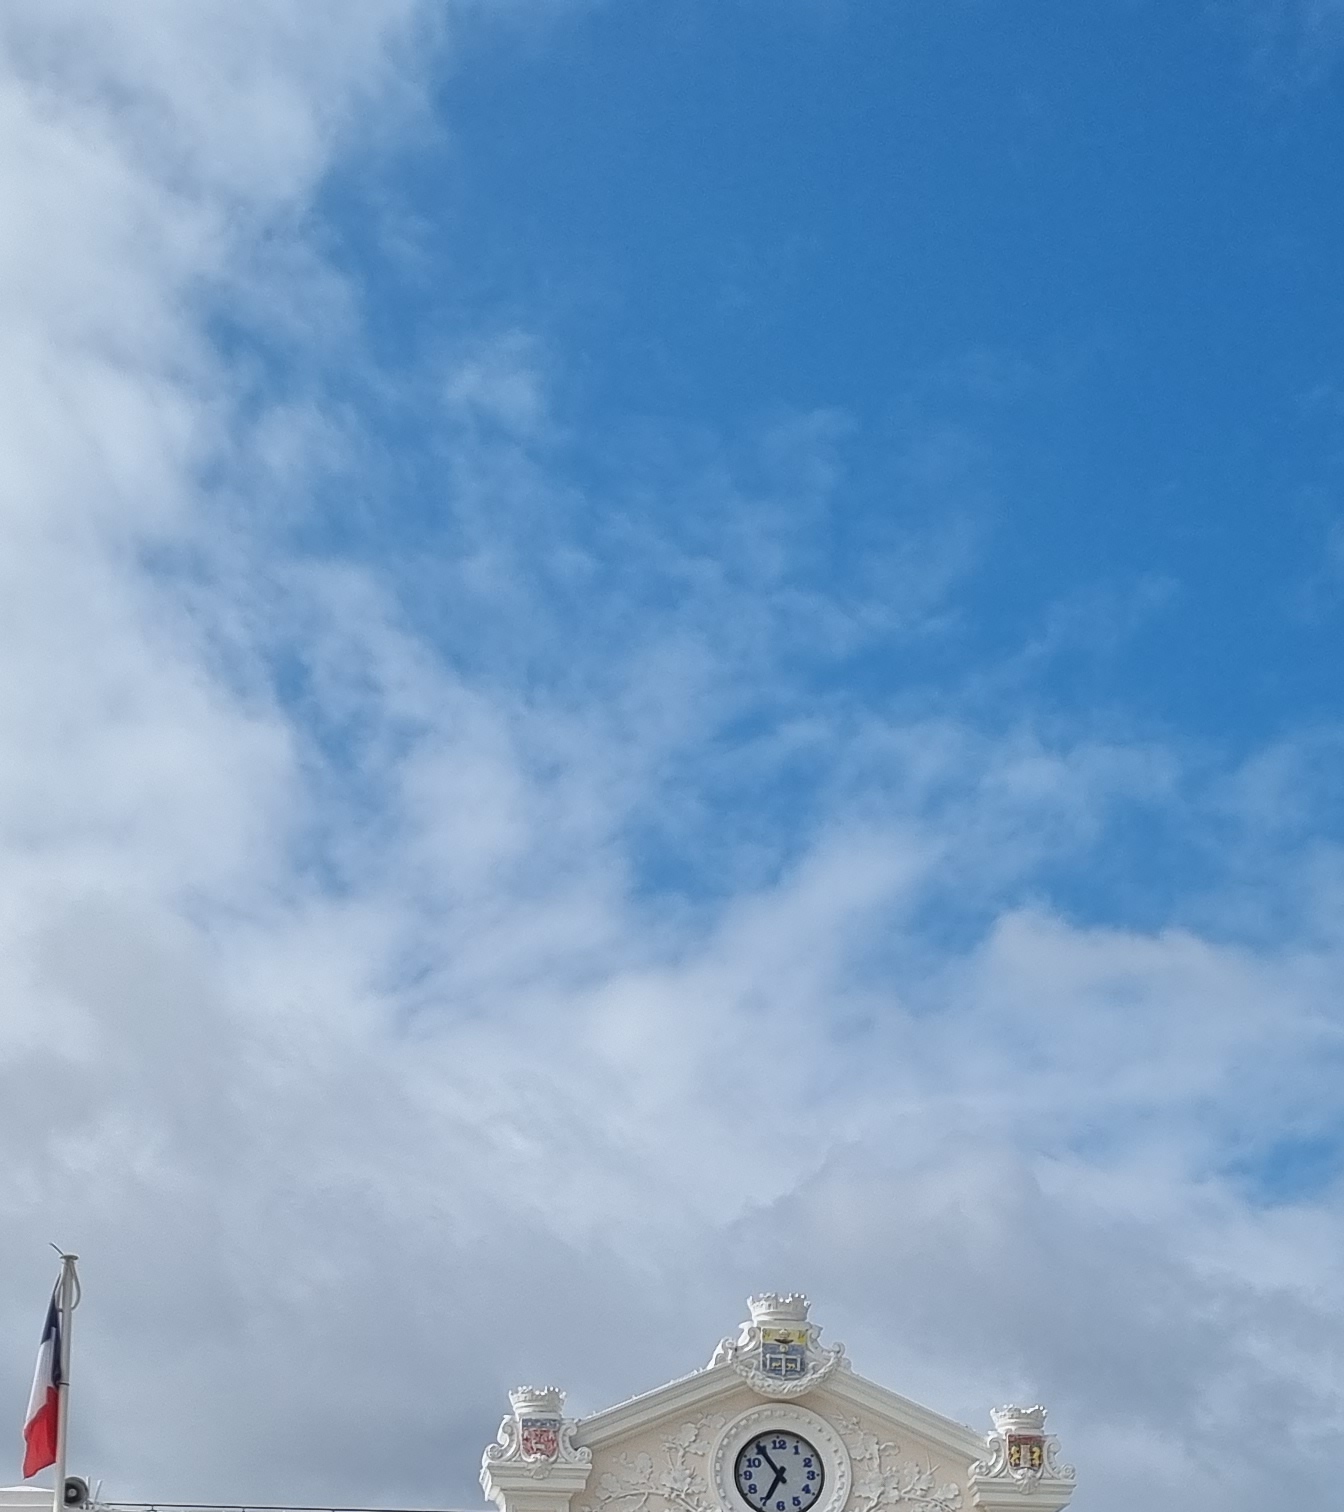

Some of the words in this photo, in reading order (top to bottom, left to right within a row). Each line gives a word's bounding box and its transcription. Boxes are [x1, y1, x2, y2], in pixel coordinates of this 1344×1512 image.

[771, 1440, 787, 1450] 12
[793, 1445, 800, 1455] 1
[746, 1457, 762, 1468] 10
[803, 1457, 812, 1468] 2
[743, 1470, 752, 1480] 9
[806, 1470, 816, 1480] 3
[748, 1483, 757, 1494] 8
[801, 1484, 811, 1494] 4
[776, 1501, 785, 1511] 6
[792, 1496, 801, 1506] 5
